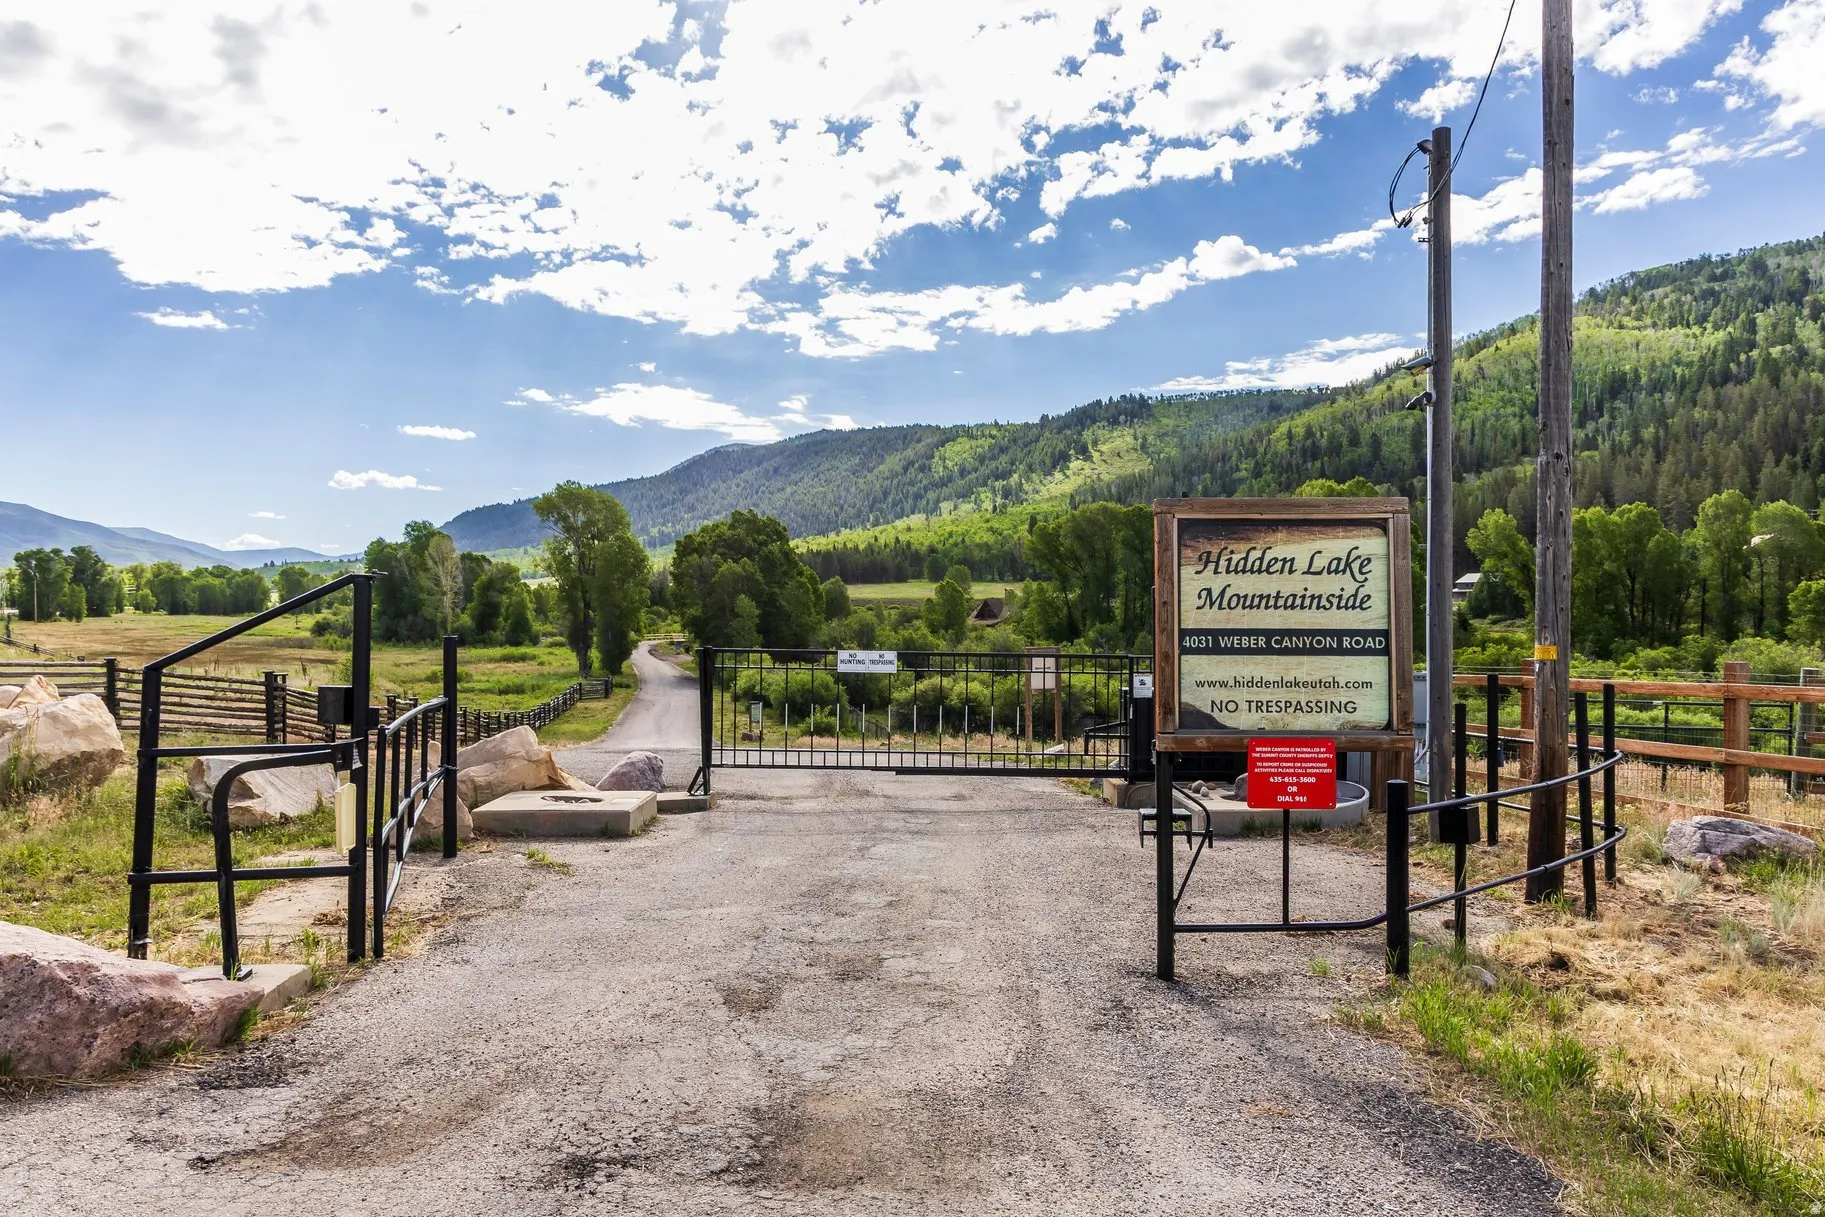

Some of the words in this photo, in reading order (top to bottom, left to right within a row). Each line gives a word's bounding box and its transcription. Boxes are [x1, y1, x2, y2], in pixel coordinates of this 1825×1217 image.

[1194, 546, 1297, 576] Hidden
[1301, 546, 1372, 583] Lake
[1196, 584, 1372, 611] Mountainside
[1183, 636, 1213, 648] 4031
[1219, 636, 1266, 648] WEBER
[1271, 636, 1337, 649] CANYON
[1343, 636, 1385, 649] ROAD
[1194, 676, 1373, 690] www.hiddenlakeutah.com
[1210, 700, 1239, 714] NO
[1245, 700, 1358, 714] TRESPASSING
